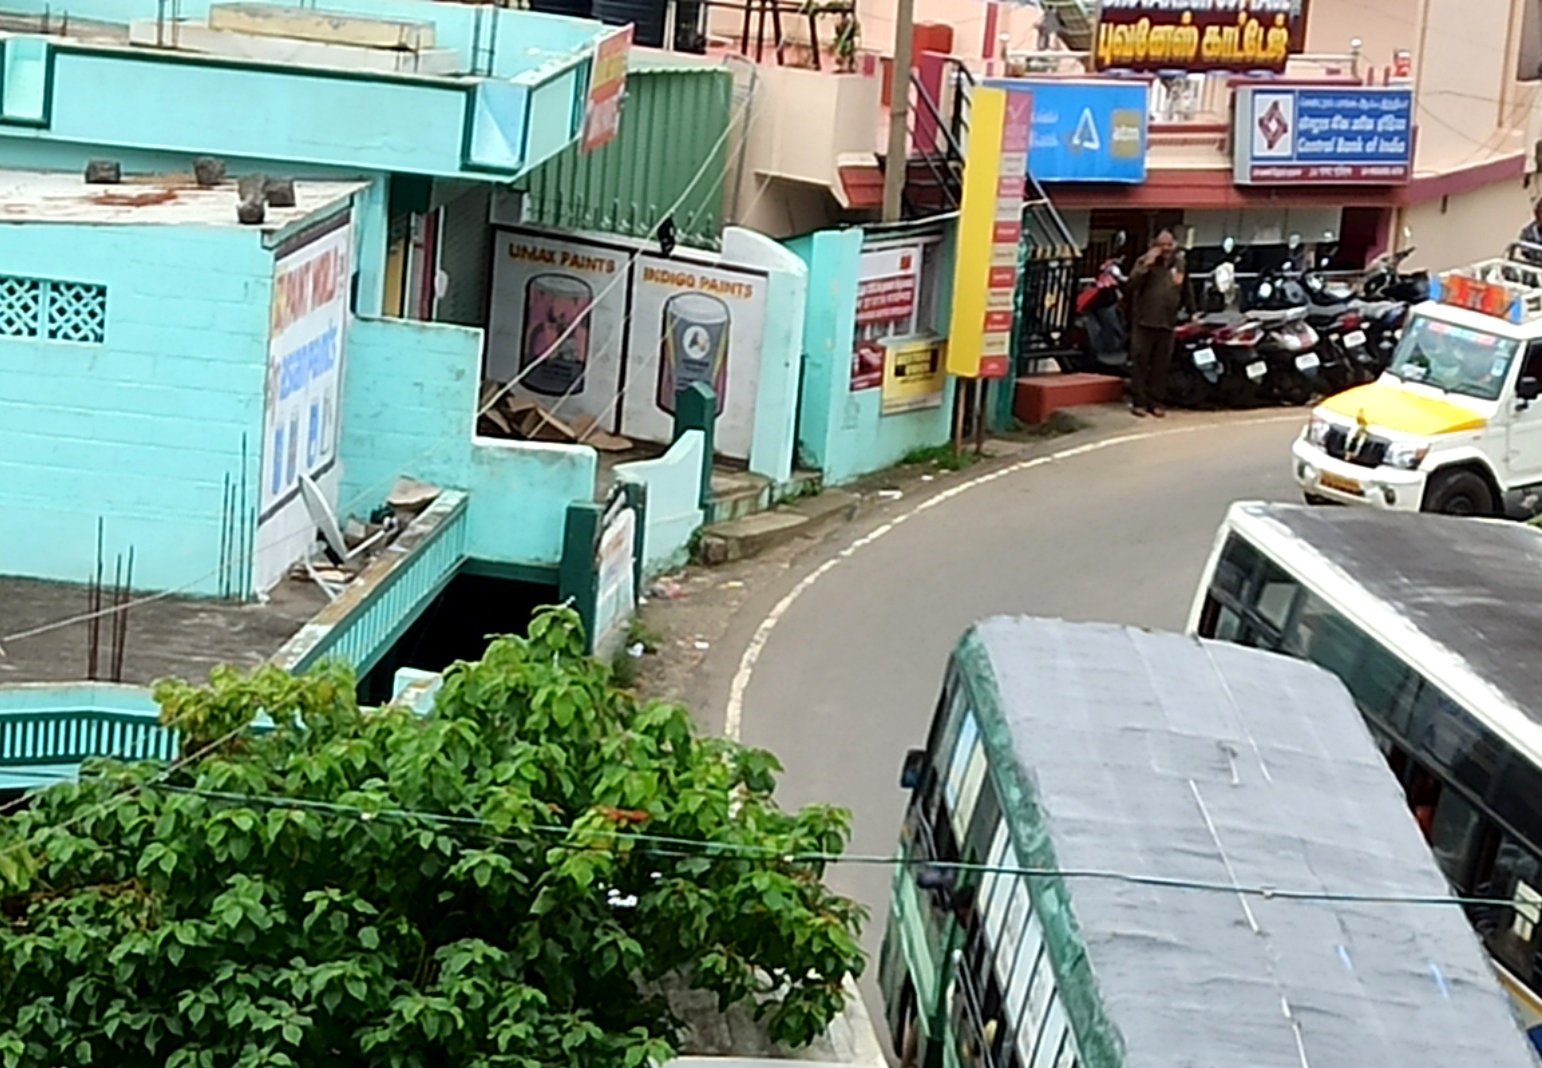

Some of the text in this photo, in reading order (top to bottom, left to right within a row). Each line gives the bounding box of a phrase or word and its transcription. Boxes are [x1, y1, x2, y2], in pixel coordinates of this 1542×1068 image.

[1298, 136, 1336, 153] Central
[1336, 135, 1363, 153] Bank
[509, 242, 616, 275] UMAX PAINTS
[642, 265, 754, 299] INDIGO PAINTS
